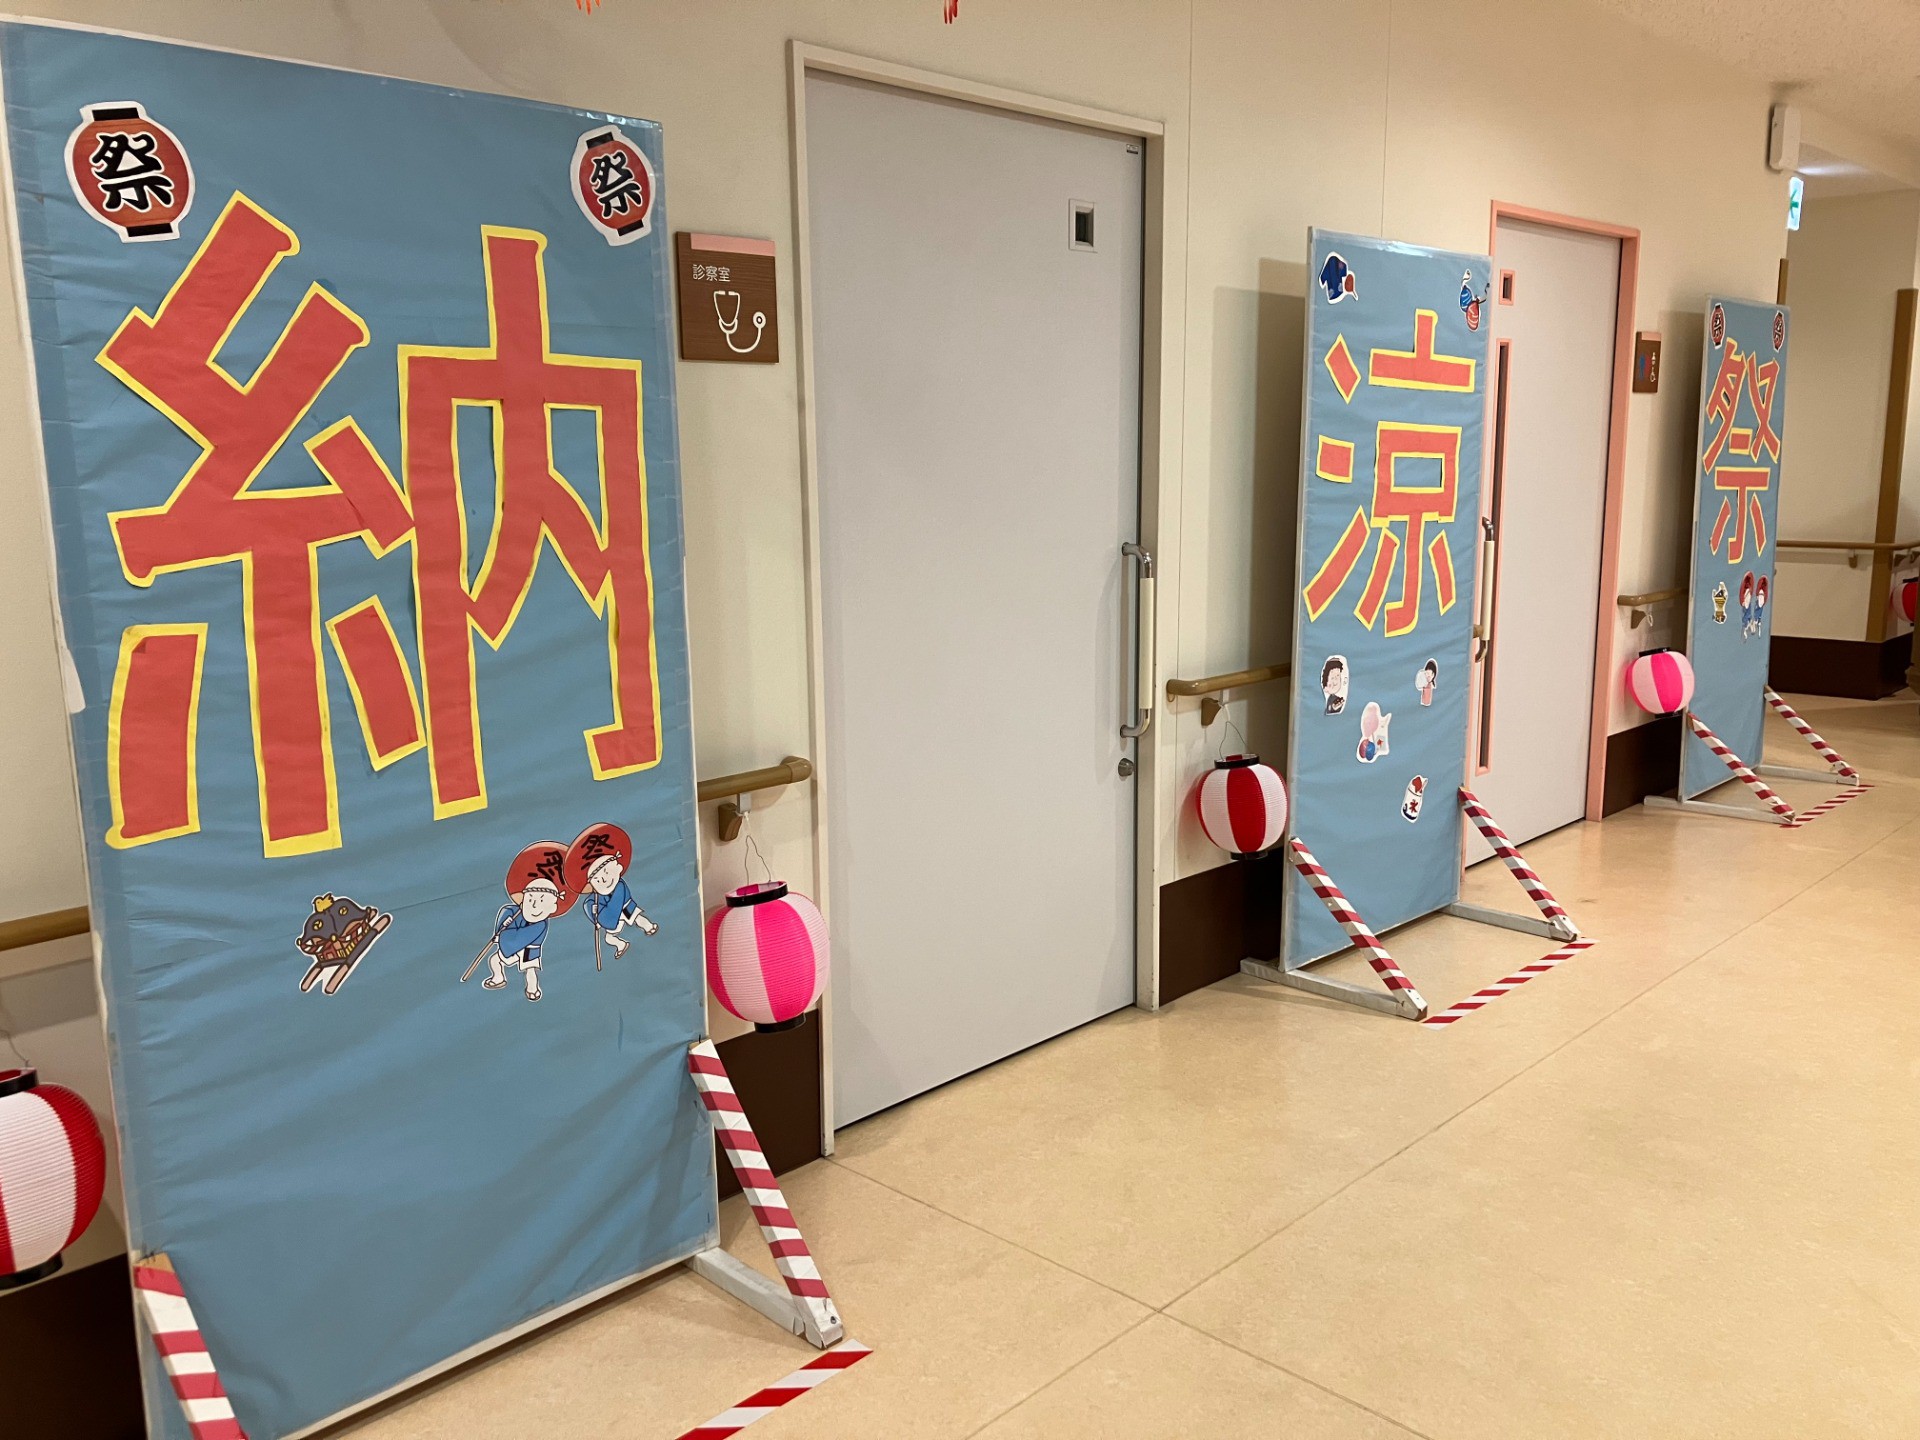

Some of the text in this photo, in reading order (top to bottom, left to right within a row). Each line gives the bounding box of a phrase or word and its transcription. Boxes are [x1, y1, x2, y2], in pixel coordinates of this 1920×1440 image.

[91, 132, 173, 210] 祭
[590, 151, 641, 217] 祭
[692, 264, 731, 282] 診察室
[95, 189, 662, 858] 納
[1302, 309, 1477, 637] 涼
[1702, 336, 1781, 564] 祭
